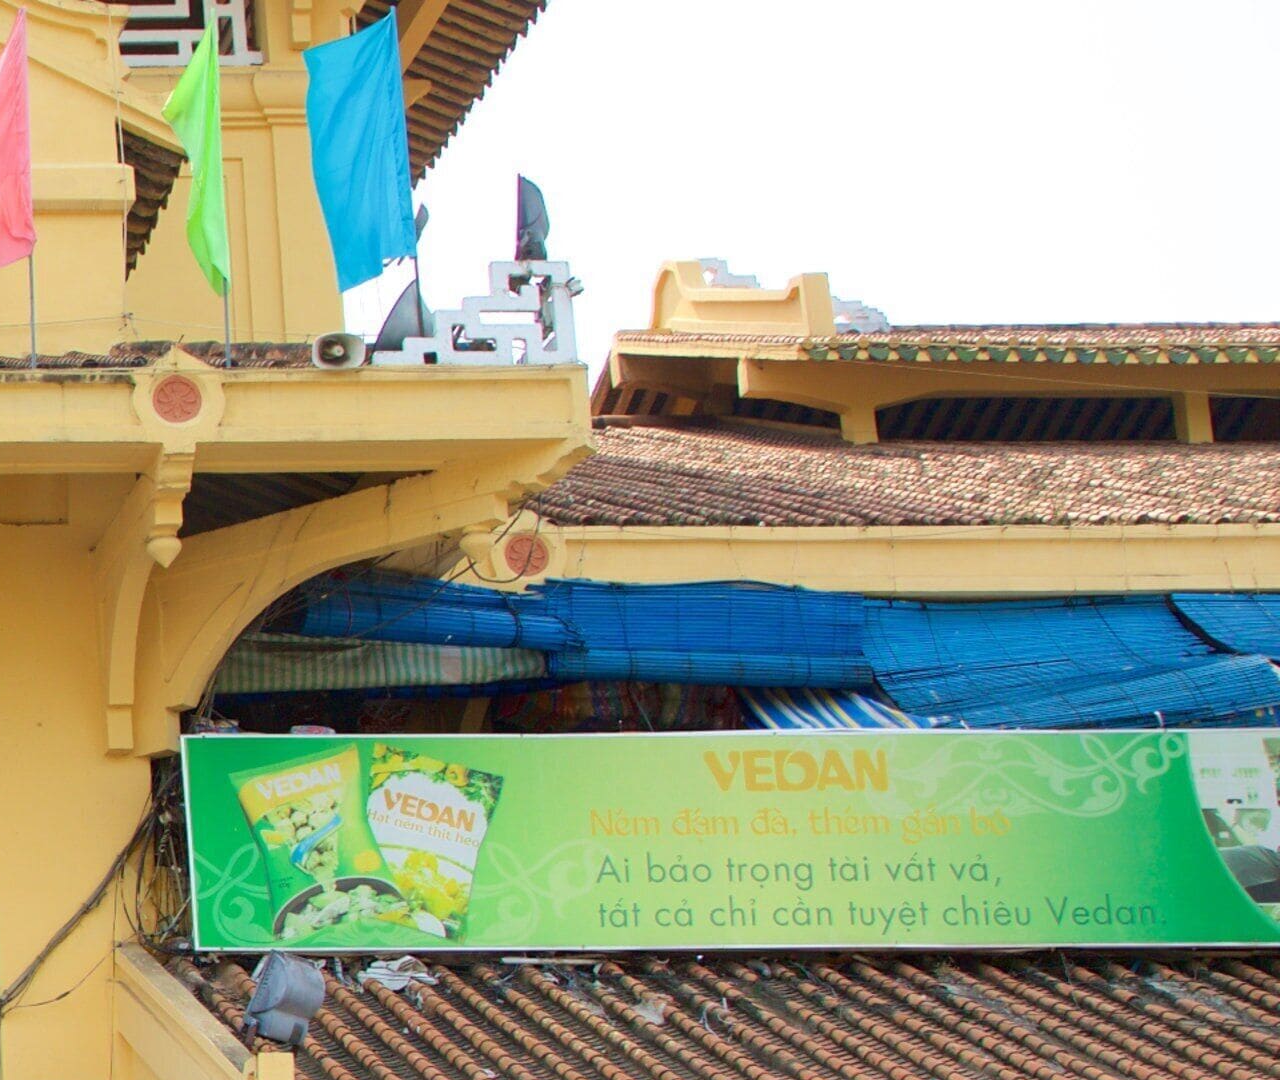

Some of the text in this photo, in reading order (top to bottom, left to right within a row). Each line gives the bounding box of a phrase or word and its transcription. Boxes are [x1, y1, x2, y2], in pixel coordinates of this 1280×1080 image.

[255, 763, 340, 800] VEDAN
[703, 750, 889, 792] VEDAN
[384, 788, 476, 833] VEDAN
[596, 851, 1003, 891] Ai bảo trọng tài vất vả,
[598, 893, 1167, 936] tất cả chỉ cần tuyệt chiêu Vedan.
